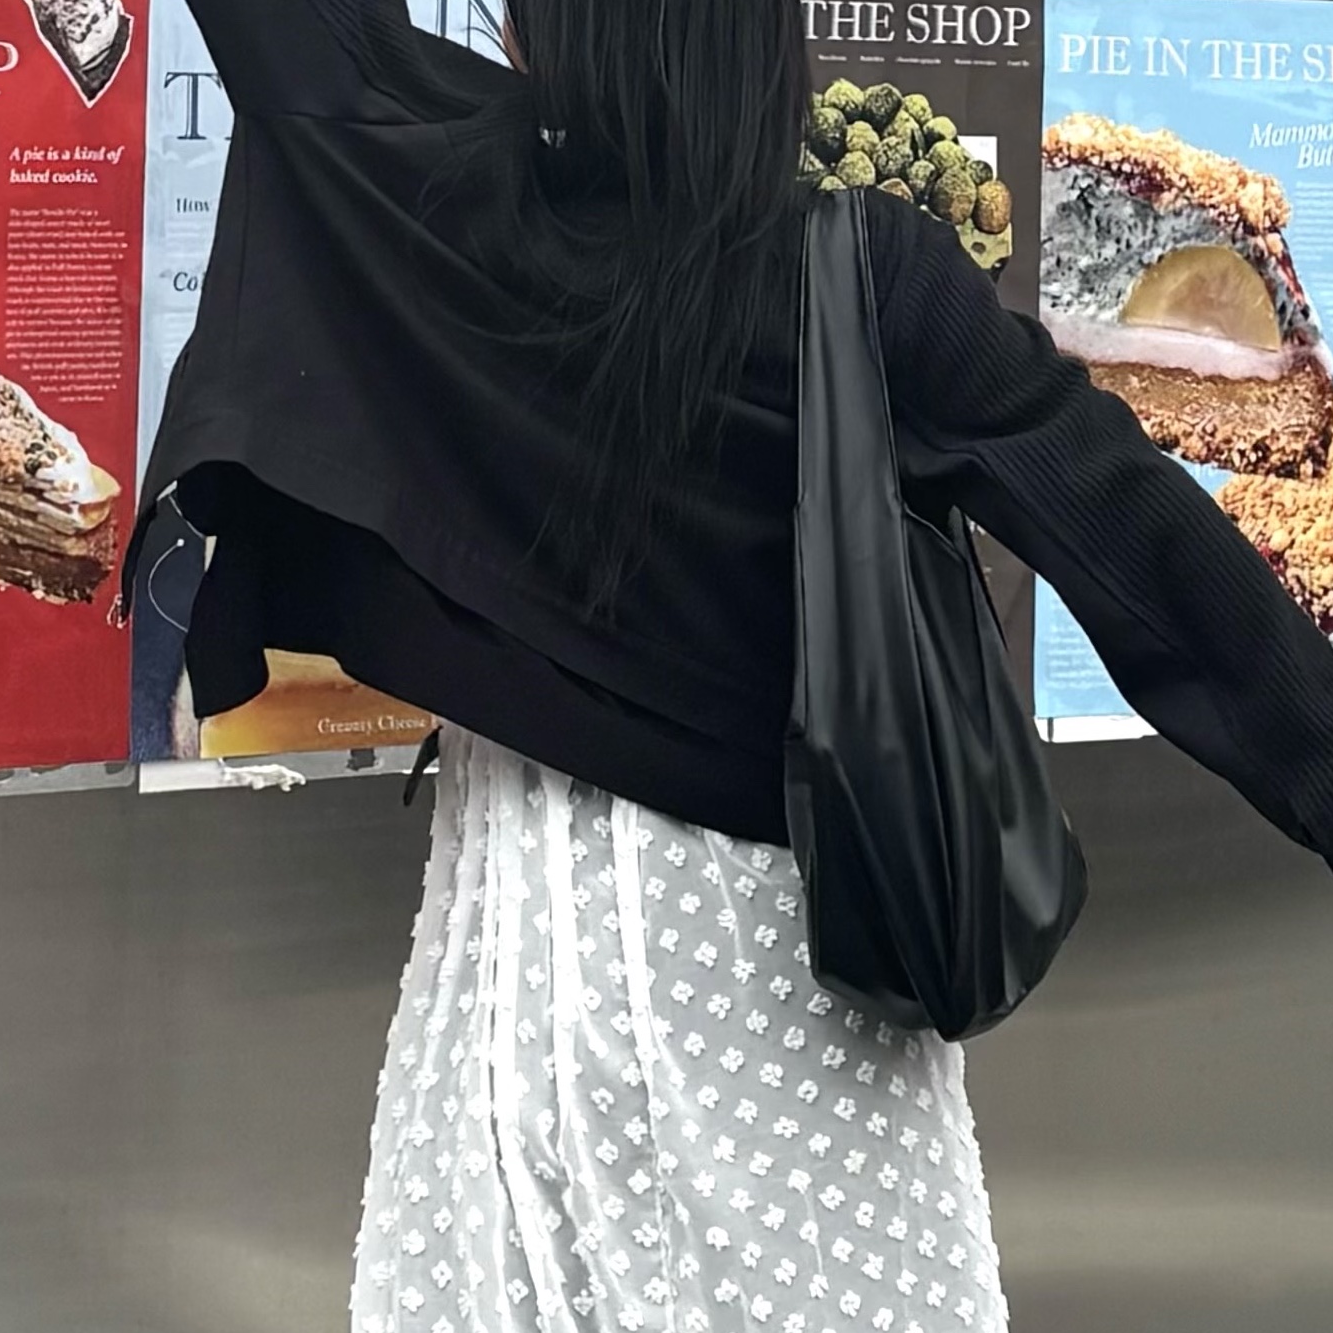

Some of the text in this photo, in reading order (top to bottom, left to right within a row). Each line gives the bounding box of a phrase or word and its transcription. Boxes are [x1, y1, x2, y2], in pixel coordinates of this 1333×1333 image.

[800, 0, 1031, 46] THE SHOP
[1058, 33, 1131, 76] PIE
[1143, 37, 1191, 77] IN
[1201, 40, 1292, 82] THE
[9, 146, 125, 164] A pie is a kind of
[173, 271, 207, 291] Co
